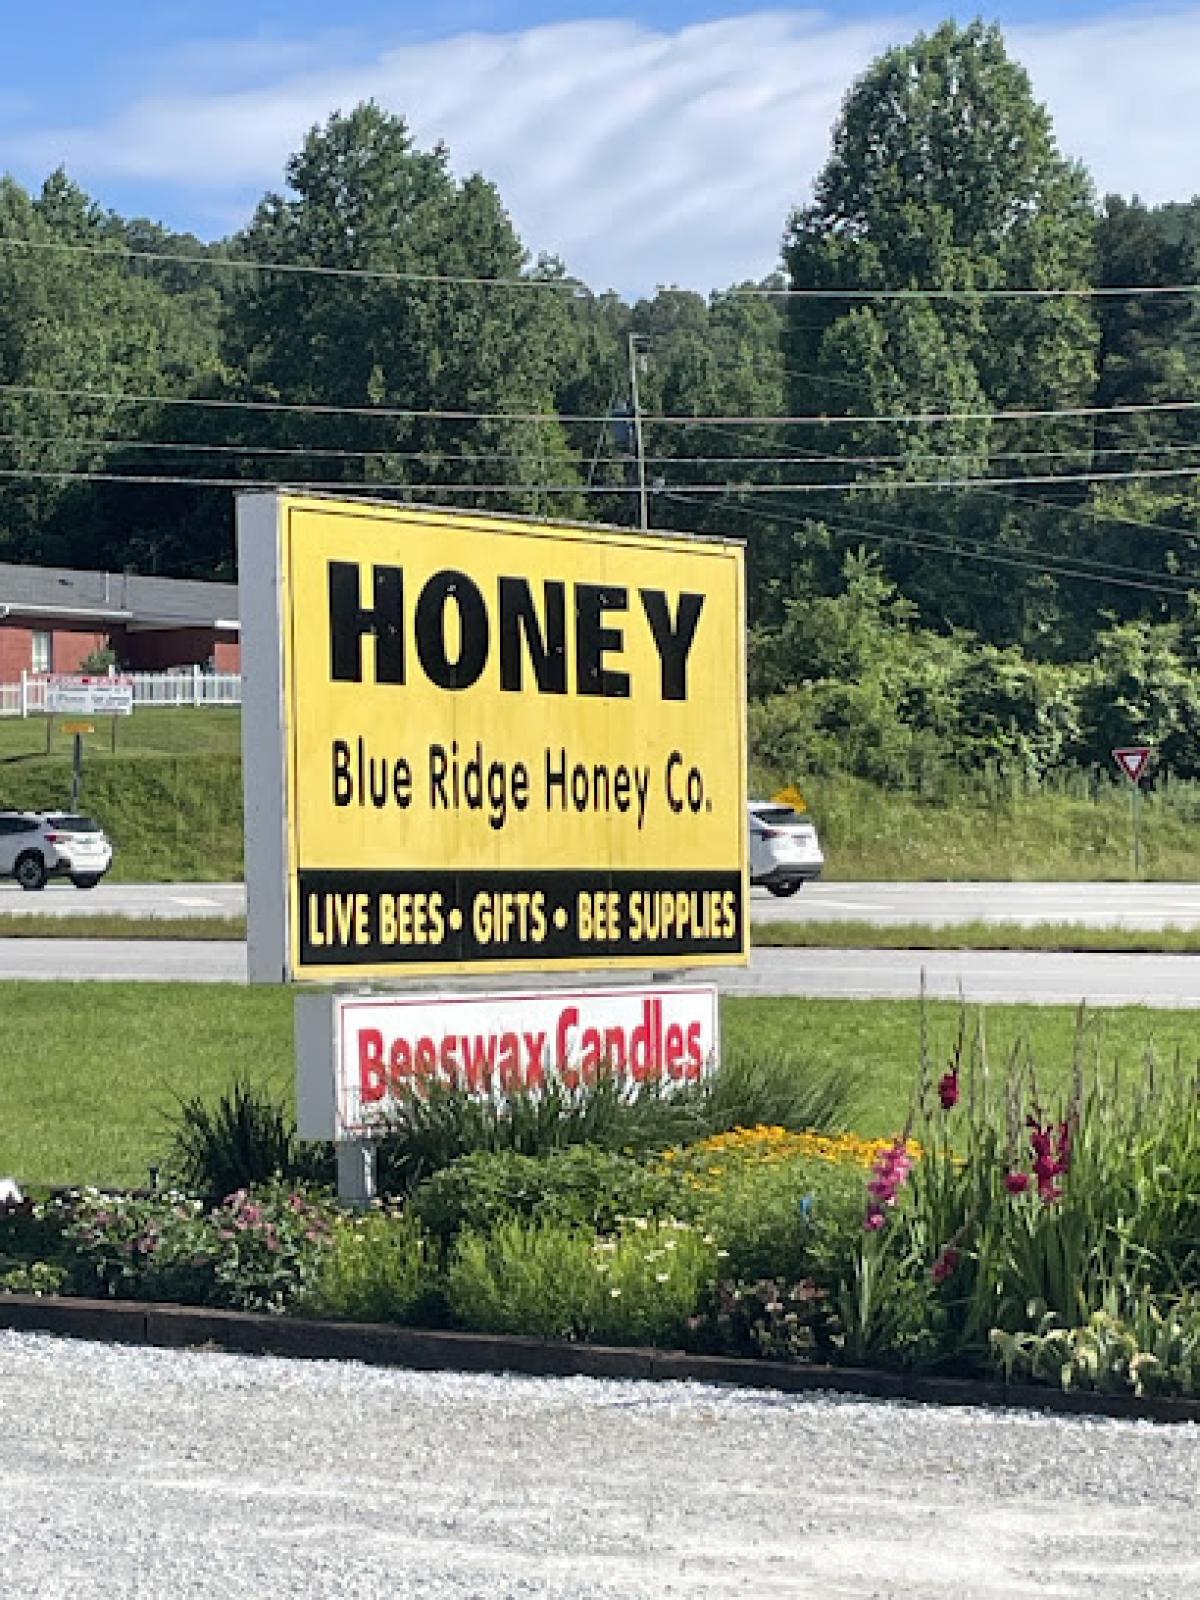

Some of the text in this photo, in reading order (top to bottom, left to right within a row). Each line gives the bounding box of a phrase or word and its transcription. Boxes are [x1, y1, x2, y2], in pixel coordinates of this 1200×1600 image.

[328, 560, 706, 701] HONEY
[332, 735, 713, 830] Blue Ridge Honey Co.
[309, 890, 736, 946] LIVE BEES GIFTS BEE SUPPLIES
[358, 997, 702, 1103] Beeswax Candles
